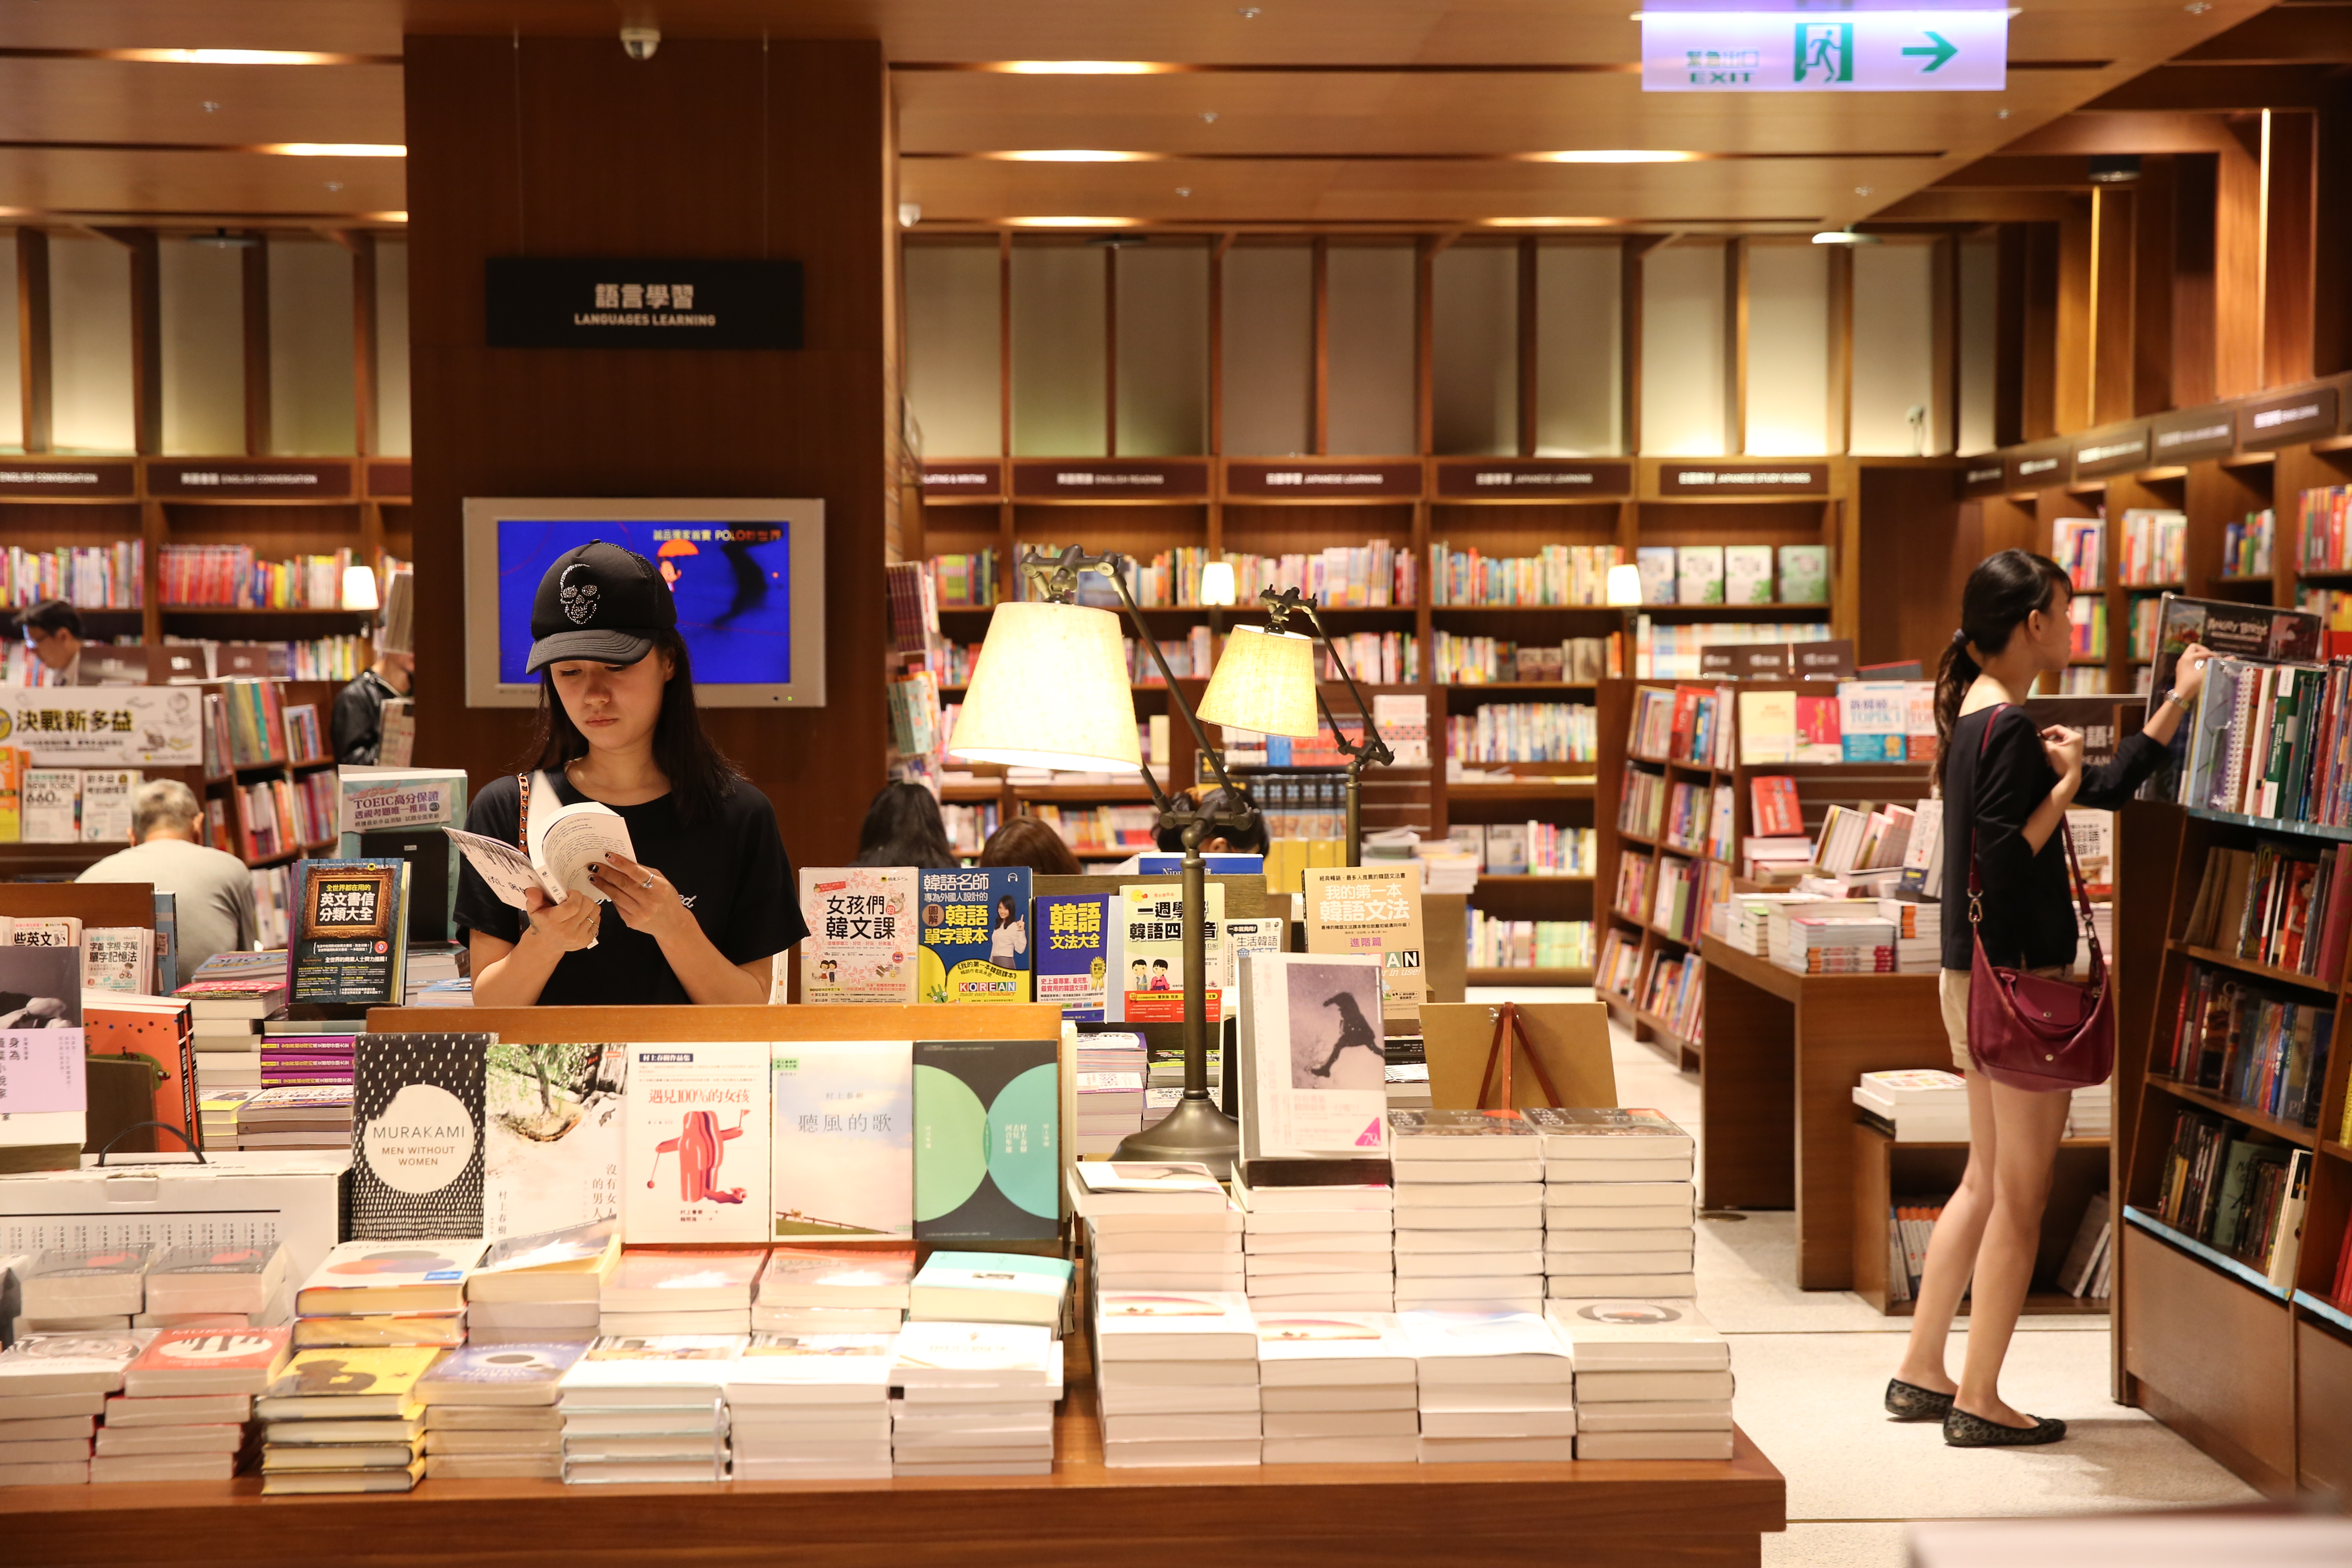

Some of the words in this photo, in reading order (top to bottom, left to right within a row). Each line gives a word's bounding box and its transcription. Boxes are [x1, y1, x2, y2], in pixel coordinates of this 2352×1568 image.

[1687, 49, 1759, 69] 緊急出口
[1690, 73, 1755, 84] EXIT
[595, 284, 694, 310] 語言學習
[574, 313, 650, 326] LANGUAGES
[652, 314, 716, 326] LEARNING
[17, 709, 133, 733] 決戰新多益
[354, 790, 439, 809] TOEIC高分保證
[326, 884, 371, 892] 全世界都在用的
[923, 873, 989, 892] 韓語名師
[1325, 882, 1402, 900] 我的第一本
[320, 892, 375, 907] 英文書信
[826, 895, 884, 915] 女孩們
[923, 892, 989, 902] 專為外國人設計的
[319, 906, 374, 922] 分類大全
[929, 906, 939, 924] 圖解
[944, 904, 989, 927] 韓語
[1049, 902, 1101, 934] 韓語
[1319, 898, 1410, 923] 韓語文法
[826, 916, 895, 940] 韓文課
[924, 927, 989, 945] 單字課本
[1049, 932, 1100, 950] 文法大全
[1236, 935, 1278, 947] 生活韓語
[1350, 937, 1382, 948] 進階篇
[89, 951, 137, 963] 單字記憶法
[1386, 951, 1418, 968] AN
[957, 960, 1017, 980] 《我的第一本韓語課本》
[1388, 967, 1399, 976] in
[1401, 966, 1421, 976] use!
[959, 982, 1016, 992] KOREAN
[9, 1037, 20, 1061] 身為
[648, 1088, 751, 1104] 遇見100%的女孩
[826, 1091, 864, 1100] 村上春樹
[373, 1126, 465, 1139] MURAKAMI
[798, 1114, 891, 1133] 聽風的歌
[408, 1146, 456, 1154] WITHOUT
[399, 1158, 438, 1166] WOMEN
[592, 1178, 603, 1219] 的男人
[498, 1190, 507, 1234] 村上春樹
